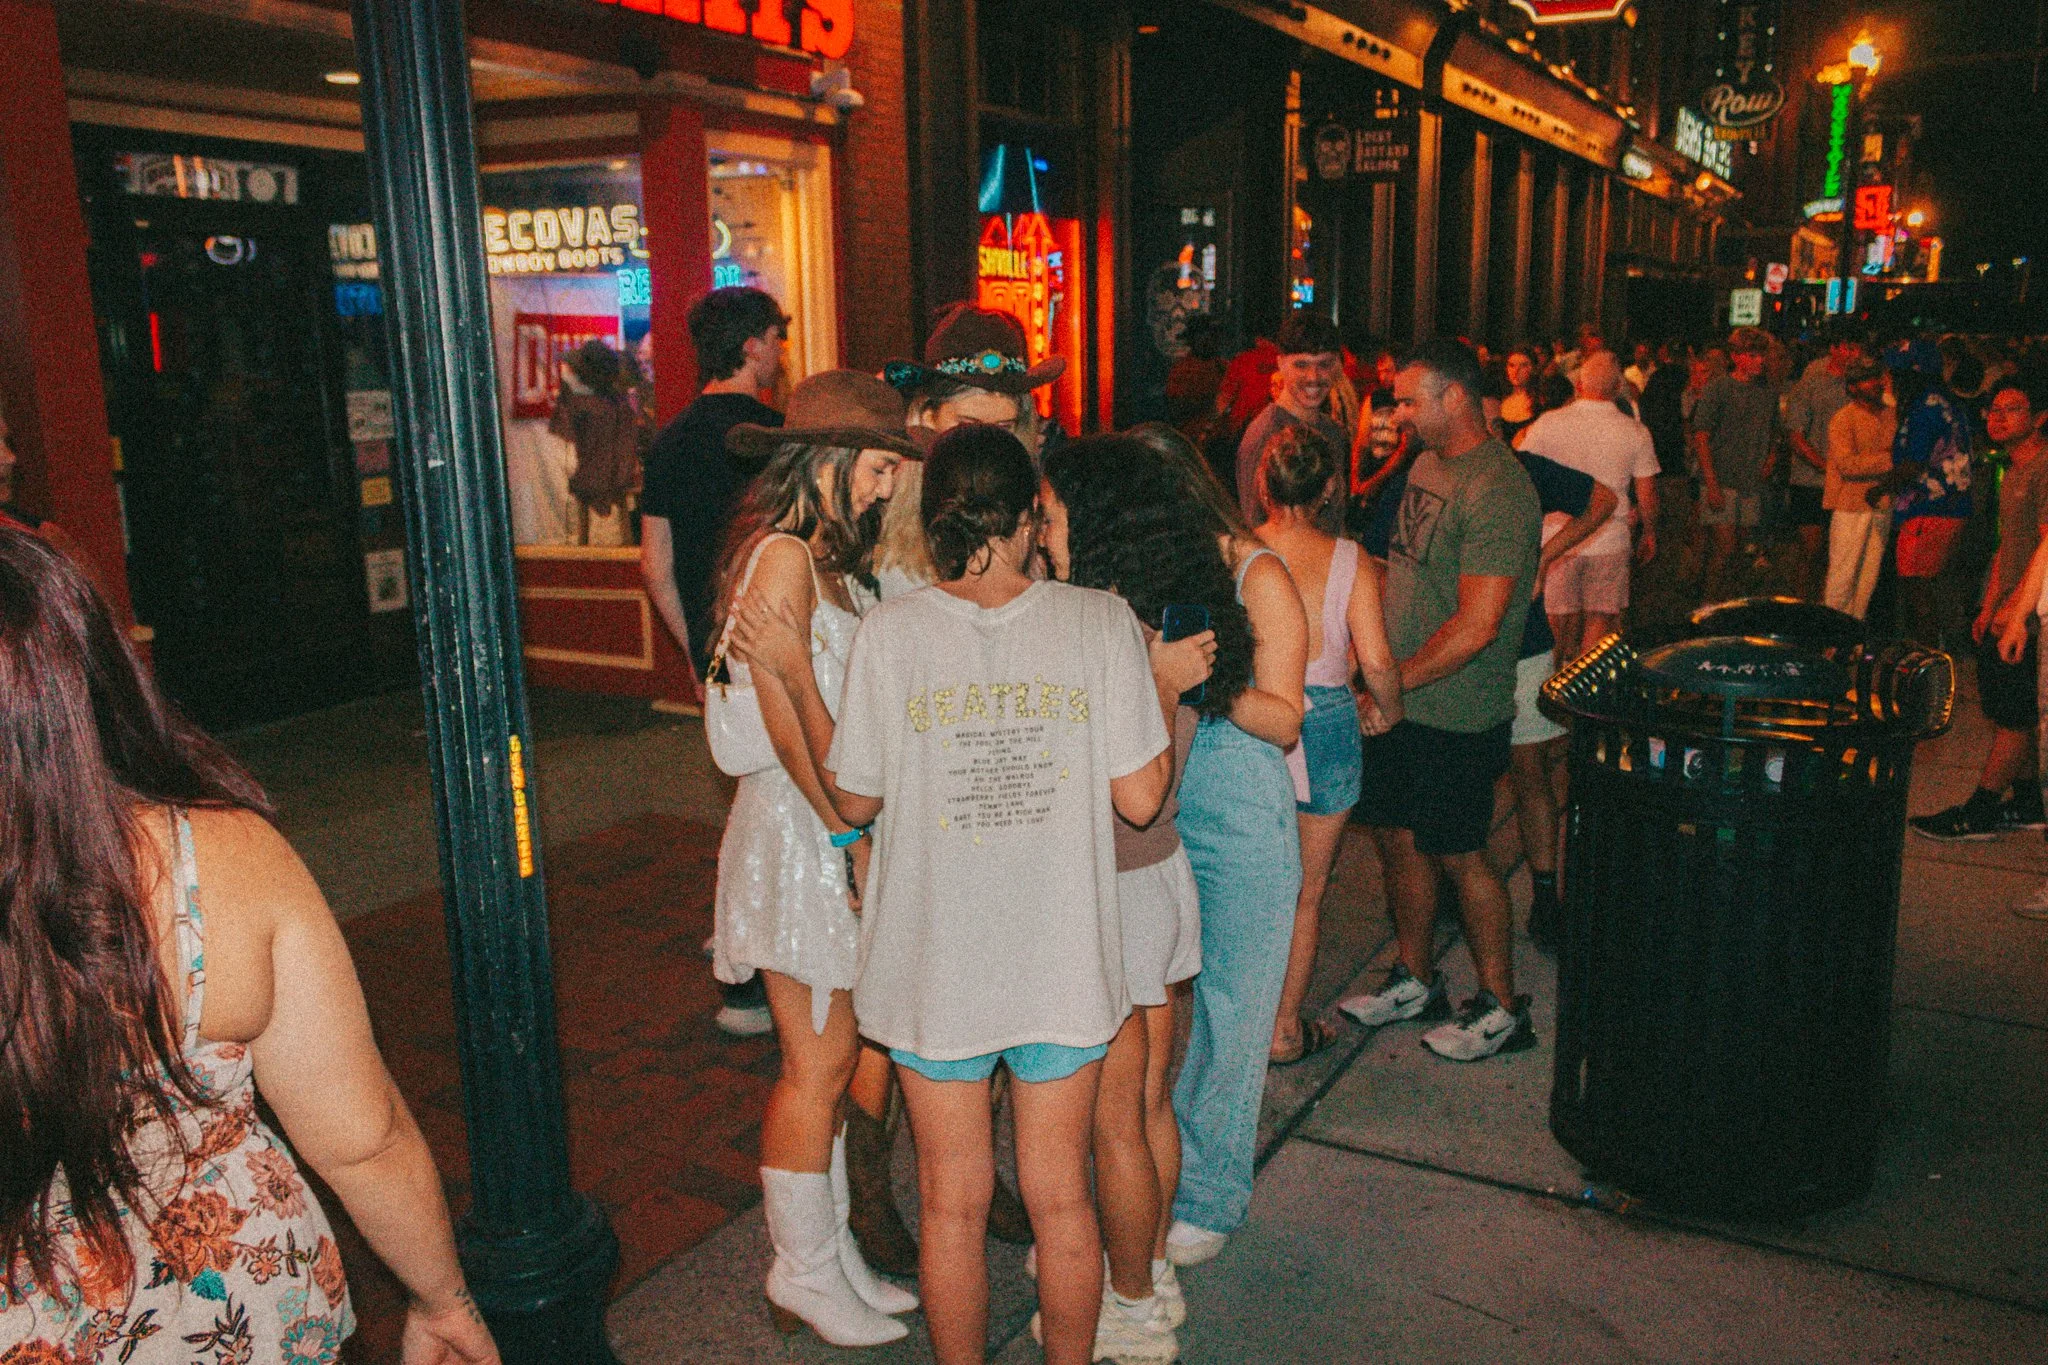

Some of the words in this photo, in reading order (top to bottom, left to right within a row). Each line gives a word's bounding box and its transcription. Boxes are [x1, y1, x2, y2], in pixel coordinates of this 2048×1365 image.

[484, 204, 641, 254] ECOVAS
[487, 251, 556, 274] OWBOY
[557, 247, 625, 270] BOOTS
[907, 682, 1090, 733] BEATLES
